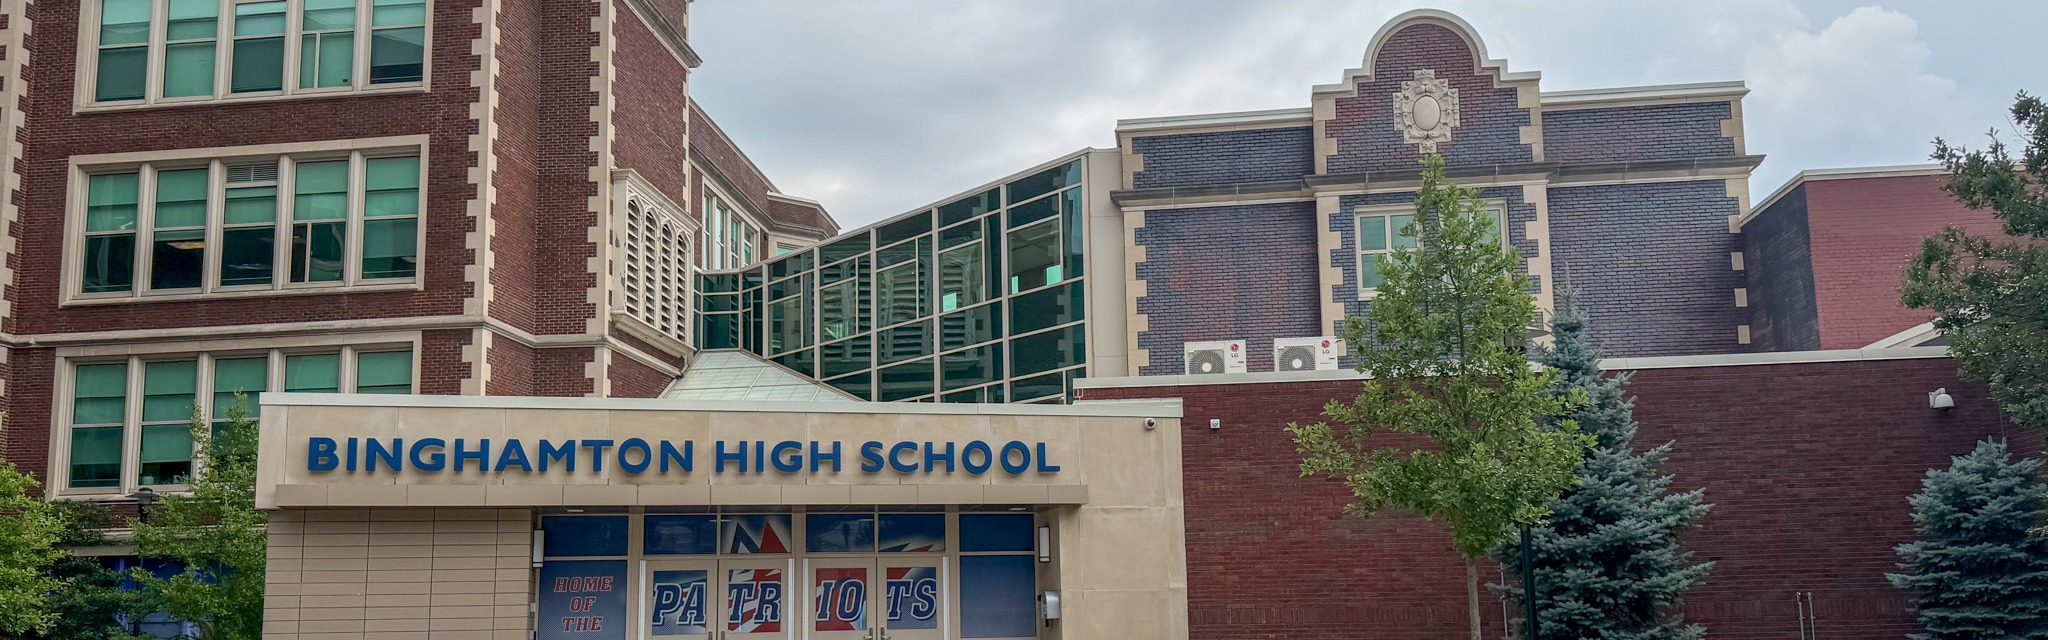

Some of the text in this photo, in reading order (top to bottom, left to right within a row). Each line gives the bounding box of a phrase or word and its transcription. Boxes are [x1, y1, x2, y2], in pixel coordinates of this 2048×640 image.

[307, 437, 1061, 475] BINGHAMTON HIGH SCHOOL
[554, 576, 614, 593] HOME
[569, 596, 597, 612] OF
[562, 616, 604, 632] THE
